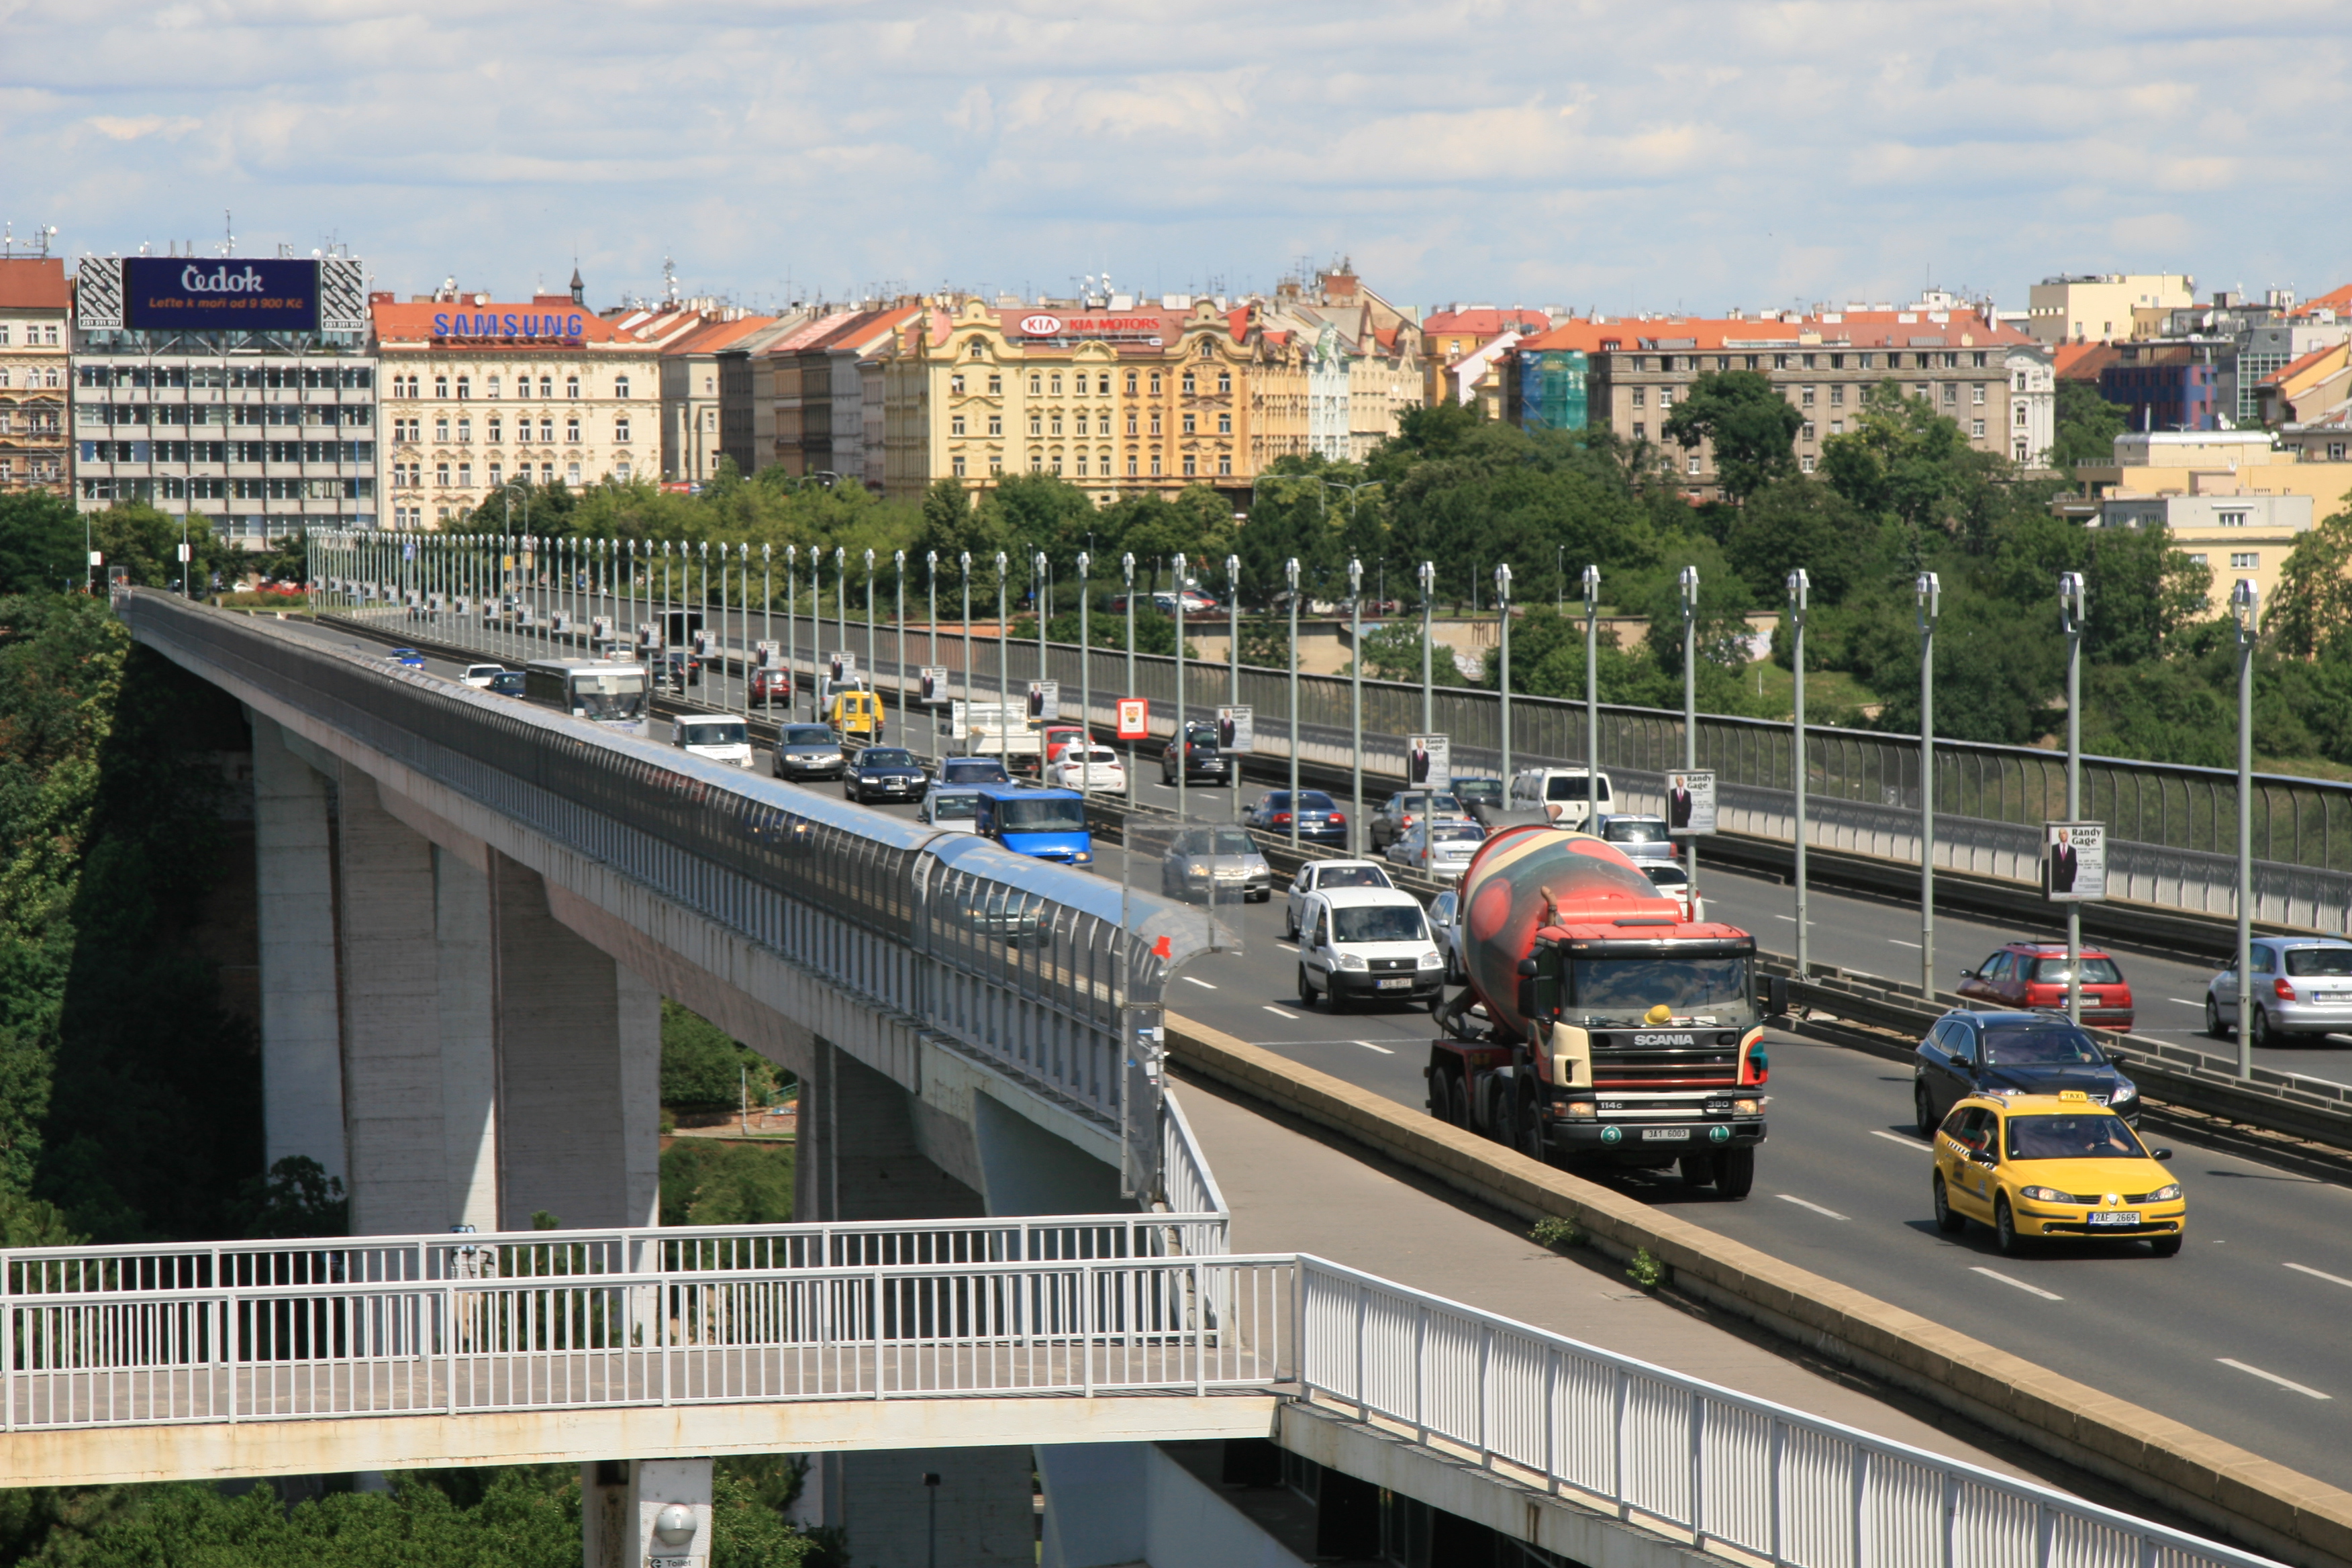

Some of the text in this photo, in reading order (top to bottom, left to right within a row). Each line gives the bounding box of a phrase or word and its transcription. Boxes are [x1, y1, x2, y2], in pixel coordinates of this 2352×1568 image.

[181, 264, 264, 292] Čedok
[187, 298, 195, 308] k
[197, 298, 227, 308] moří
[230, 299, 245, 308] od
[249, 299, 258, 308] 9
[260, 299, 283, 309] 900
[286, 298, 304, 309] Kč
[434, 313, 583, 336] SAMSUNG
[1028, 320, 1055, 330] KIA
[1070, 317, 1160, 330] KIA MOTORS
[2072, 828, 2102, 837] Randy
[2071, 837, 2096, 846] Gage
[1634, 1034, 1694, 1046] SCANIA
[1607, 1130, 1616, 1140] 3
[1667, 1130, 1686, 1138] 6003
[1714, 1130, 1723, 1140] L
[2095, 1214, 2136, 1222] 2AE 2665
